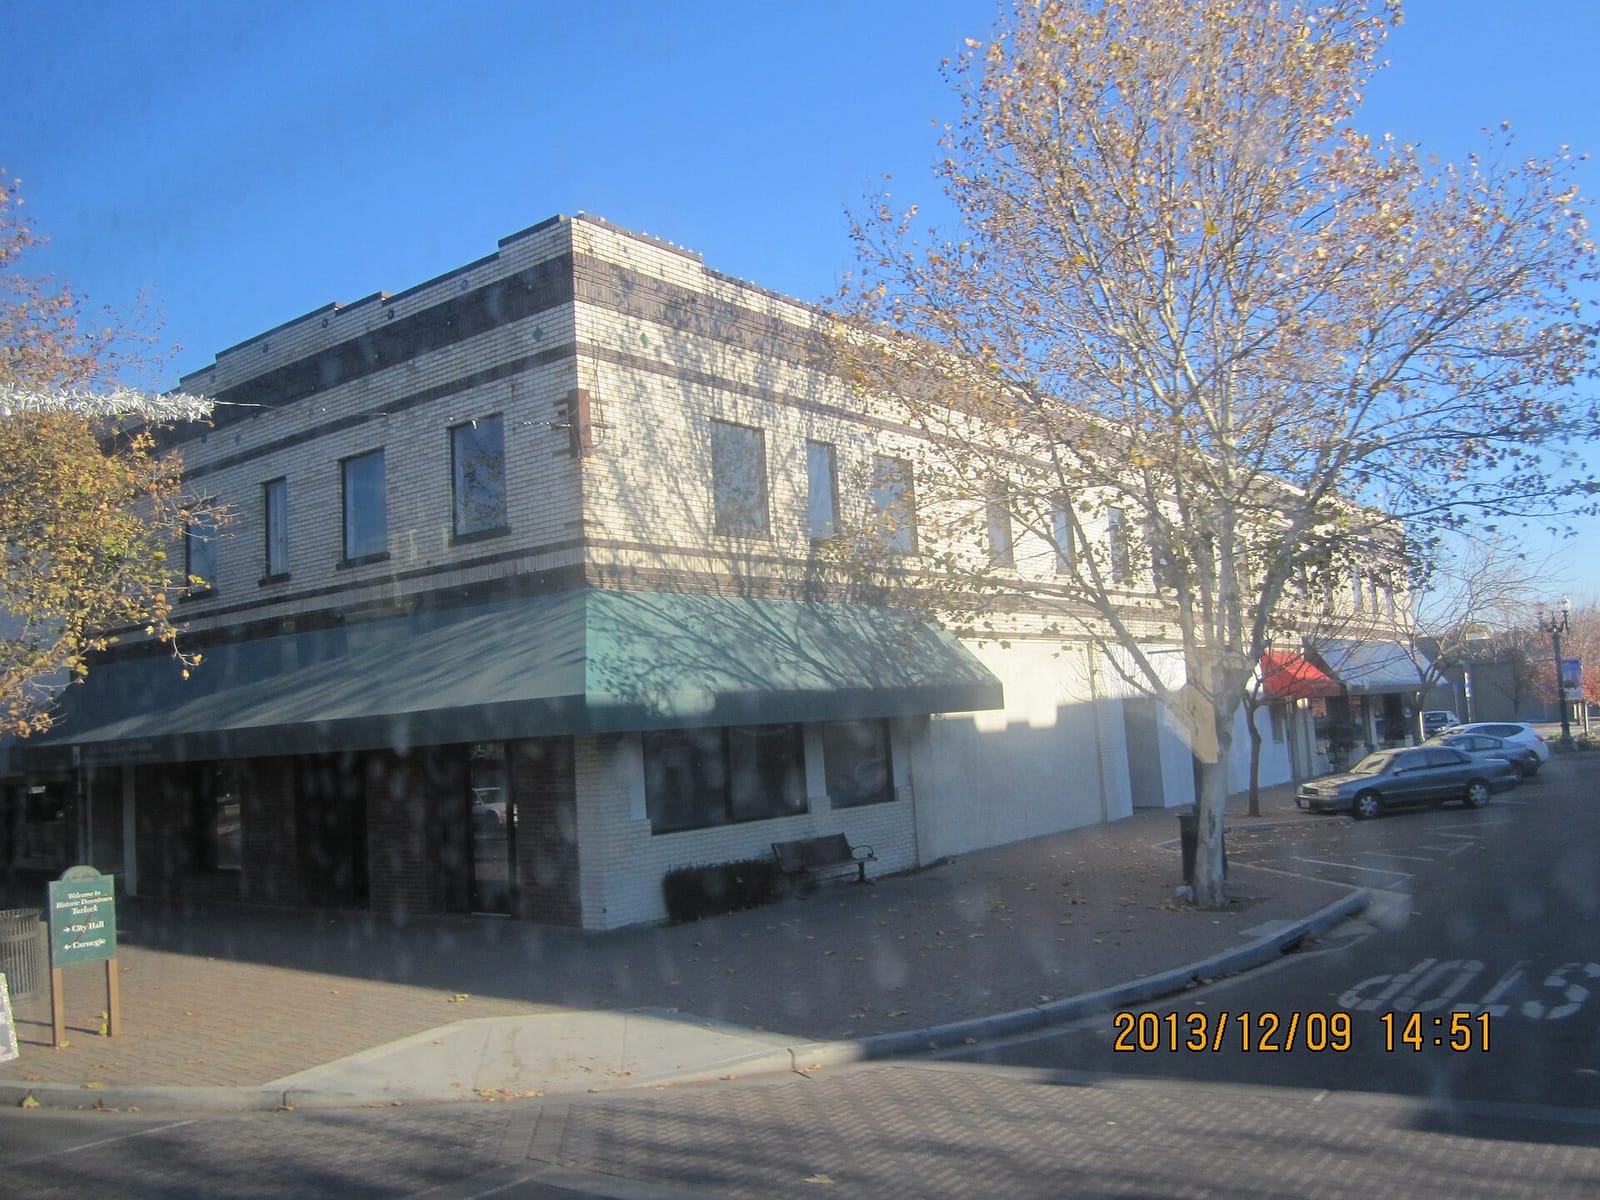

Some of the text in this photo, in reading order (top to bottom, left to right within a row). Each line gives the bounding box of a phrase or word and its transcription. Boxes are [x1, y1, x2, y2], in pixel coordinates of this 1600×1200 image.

[67, 892, 94, 900] Welcome
[56, 901, 81, 909] Historic
[72, 904, 98, 915] Turlock
[71, 920, 105, 933] City Hall
[72, 937, 107, 949] Carnegie
